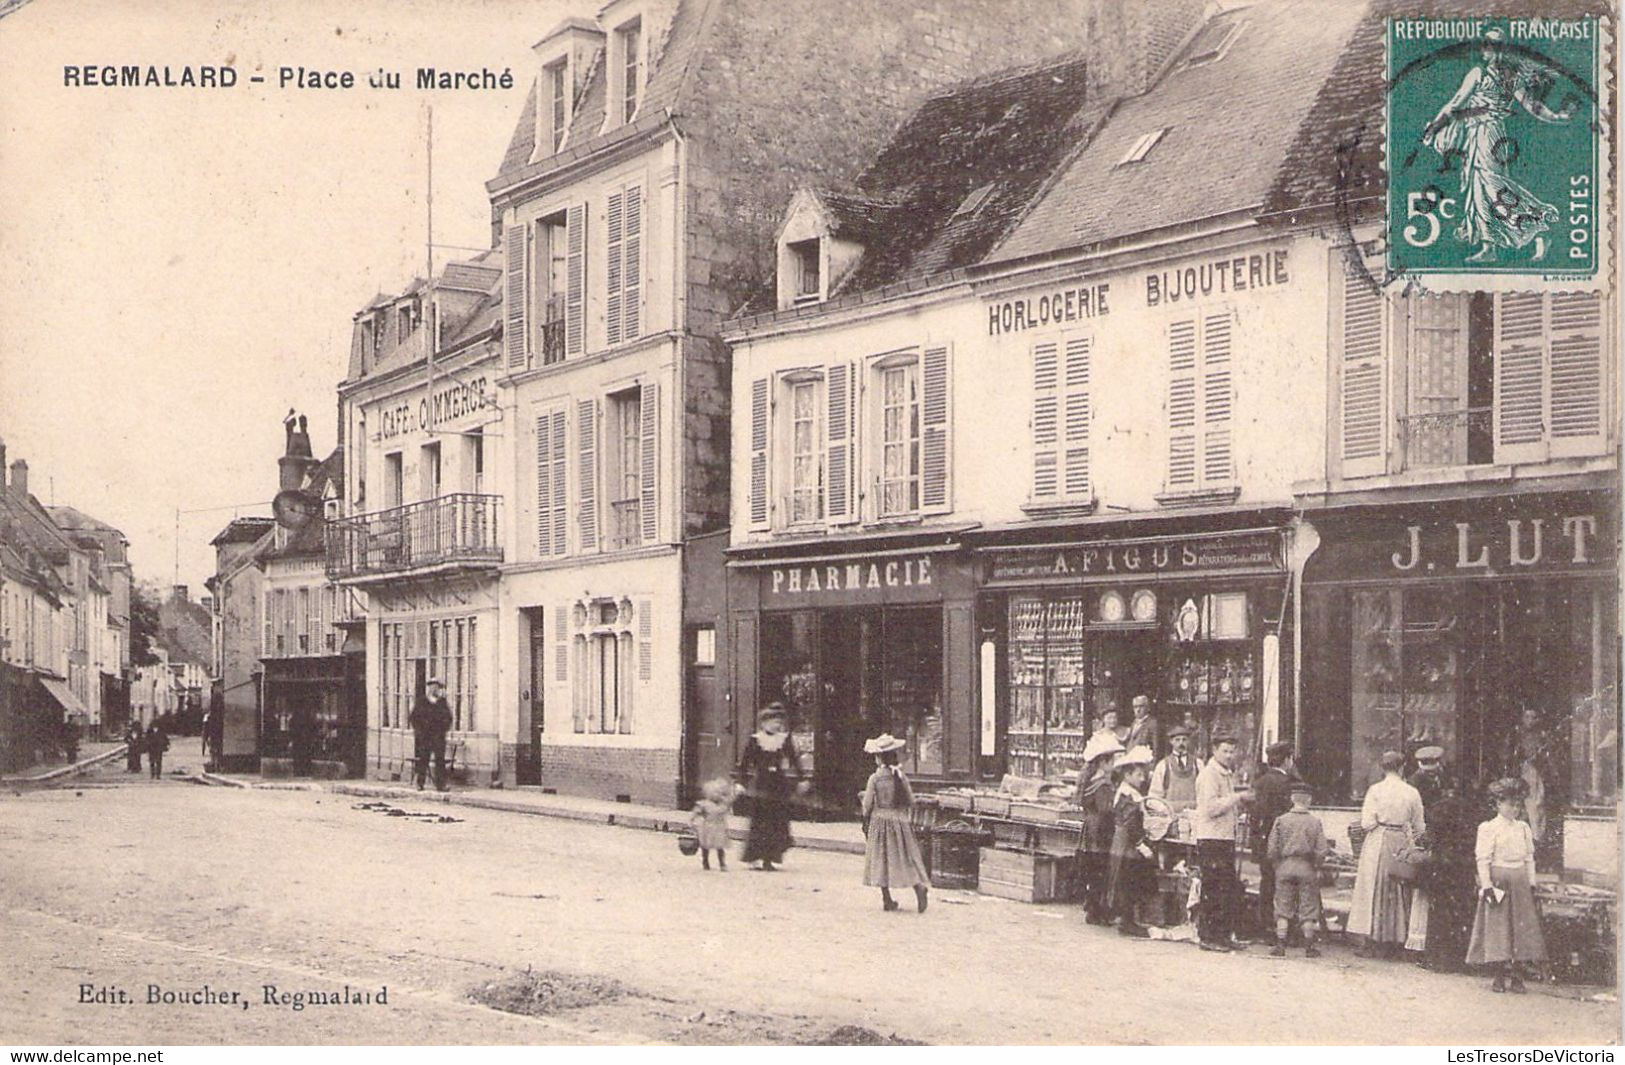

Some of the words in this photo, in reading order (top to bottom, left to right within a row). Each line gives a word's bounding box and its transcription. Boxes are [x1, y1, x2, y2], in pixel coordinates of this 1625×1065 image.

[1510, 20, 1590, 41] FRANÇAISE
[1569, 174, 1589, 258] POSTES
[988, 283, 1110, 336] HORLOGERIE
[1146, 250, 1289, 307] BIJOUTERIE
[419, 376, 487, 430] CMMERCE
[1052, 551, 1076, 574] A.
[1391, 525, 1435, 571] J.
[1455, 515, 1597, 569] LUT
